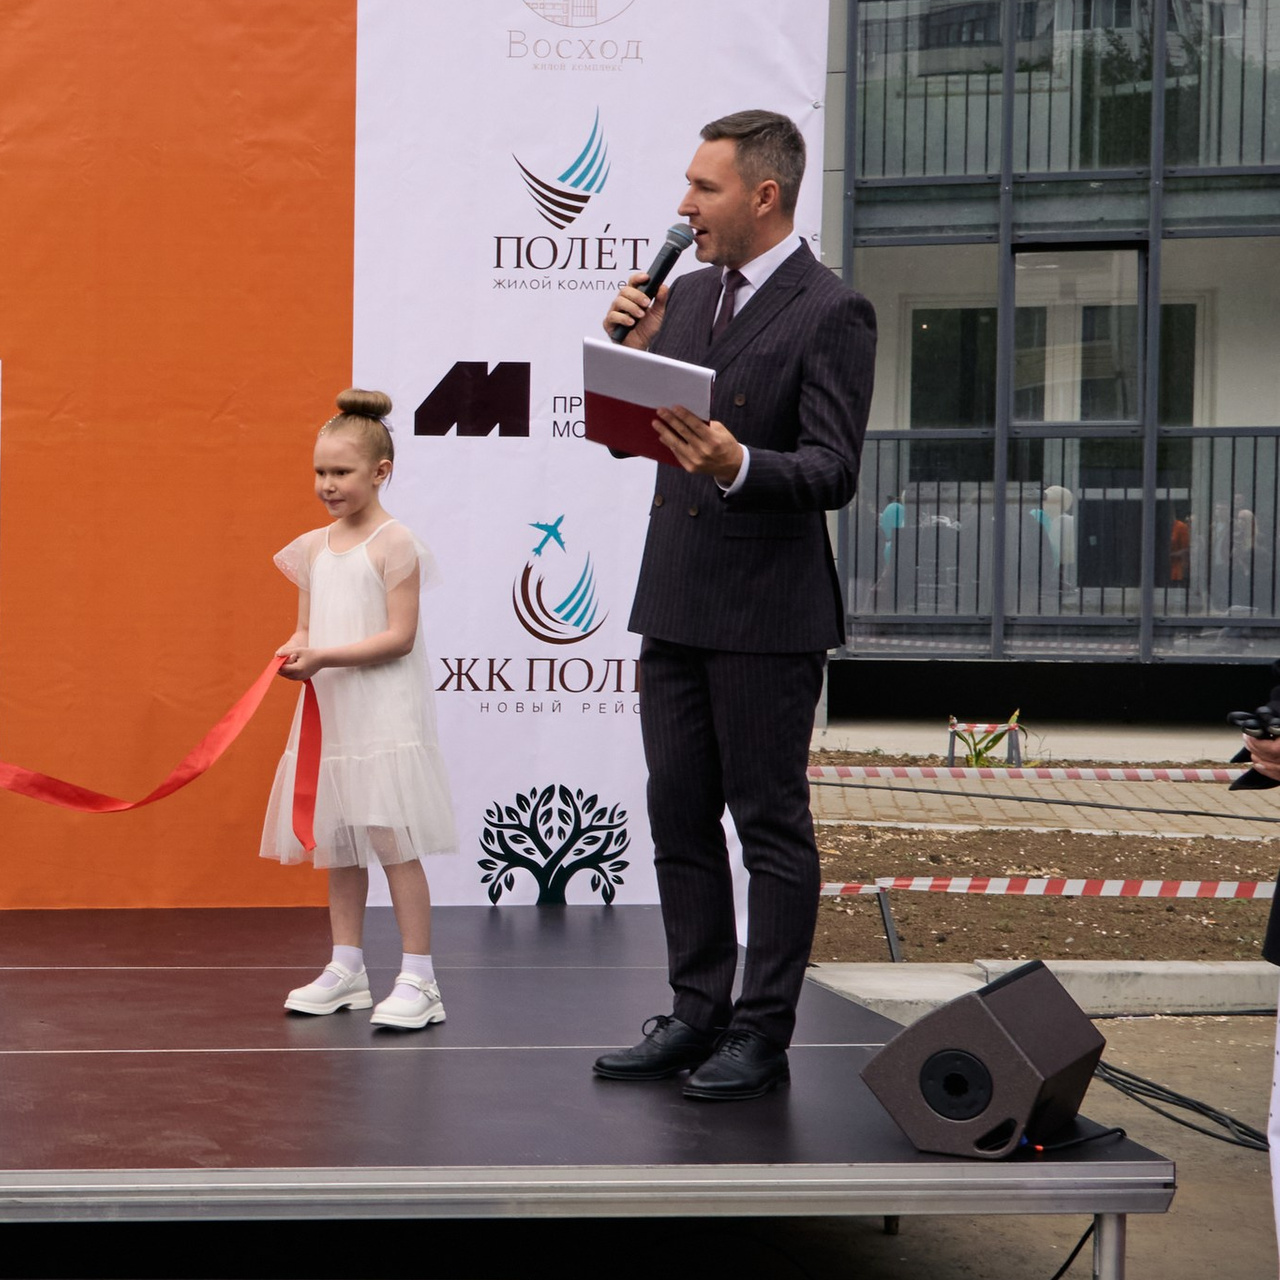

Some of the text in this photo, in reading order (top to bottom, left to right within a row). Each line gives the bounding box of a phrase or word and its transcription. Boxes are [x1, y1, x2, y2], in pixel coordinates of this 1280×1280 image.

[552, 396, 583, 414] ПР
[435, 657, 641, 693] ЖК ПОЛ
[479, 699, 562, 713] НОВЫЙ
